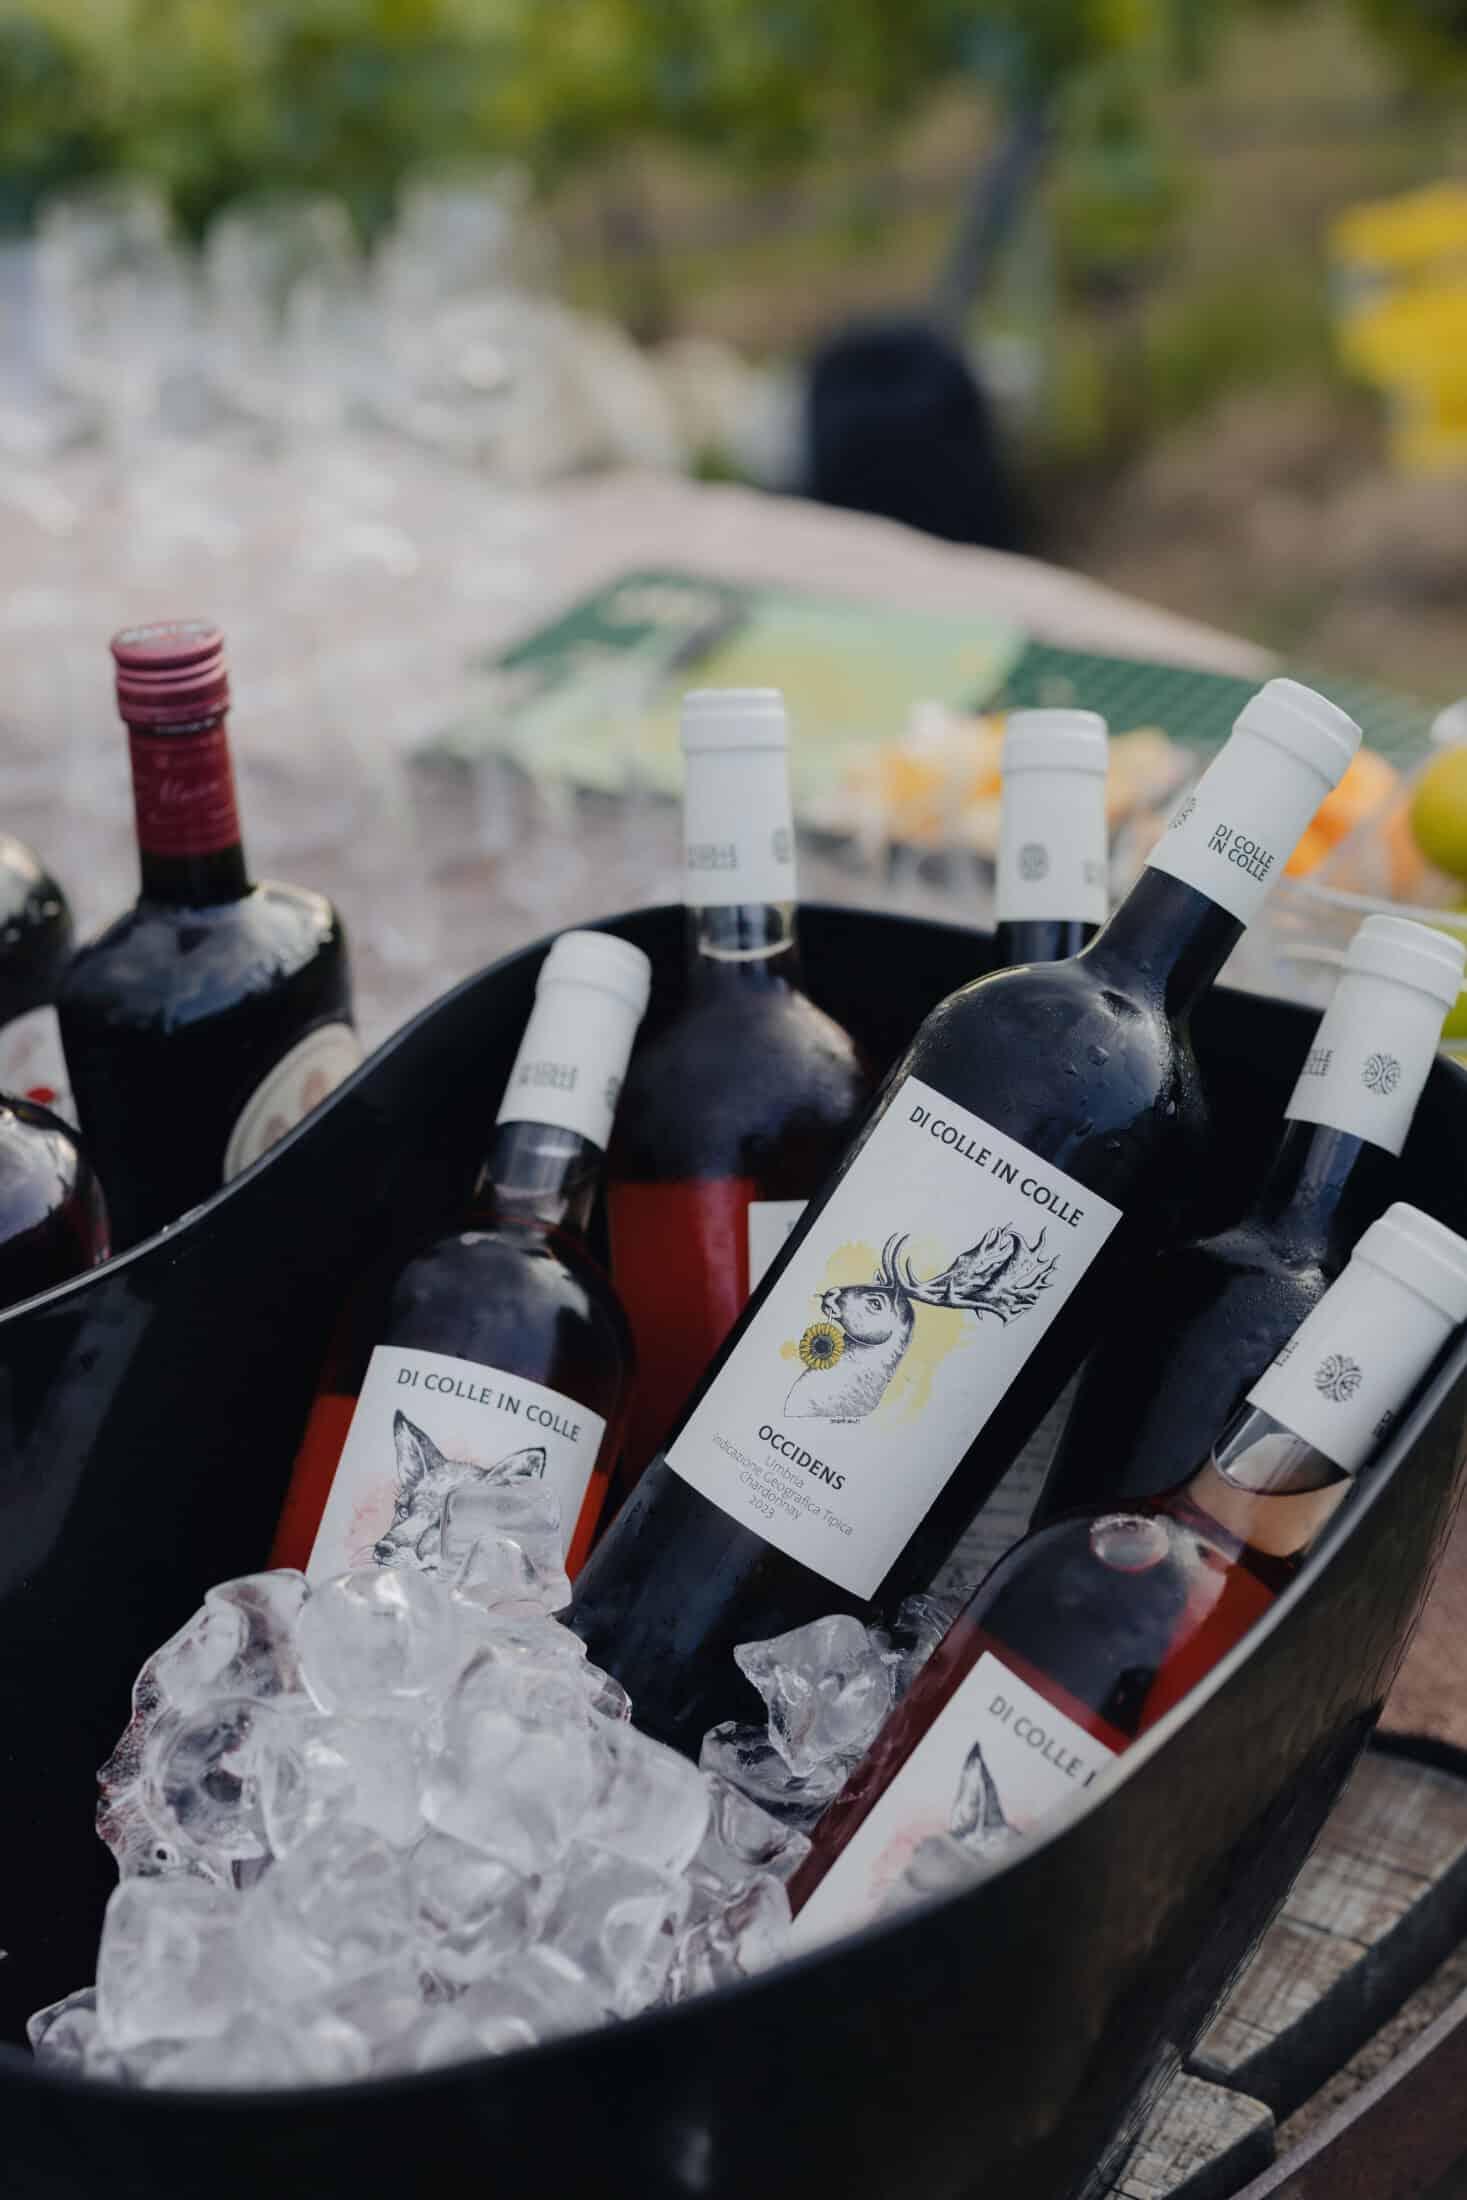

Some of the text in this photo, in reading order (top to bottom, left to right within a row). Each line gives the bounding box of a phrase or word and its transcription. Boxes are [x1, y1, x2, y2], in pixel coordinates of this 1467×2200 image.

[1207, 836, 1269, 882] IN COLLE
[1215, 823, 1275, 869] DI COLLE
[909, 1105, 1085, 1228] DI COLLE IN COLLE
[397, 1368, 582, 1442] DI COLLE IN COLLE
[758, 1424, 846, 1490] OCCIDENS
[765, 1456, 804, 1489] Umbria
[738, 1471, 802, 1521] Chardonnay
[749, 1494, 776, 1520] 2023
[762, 1470, 821, 1515] Geografica
[823, 1508, 854, 1537] Tipica
[989, 1695, 1014, 1722] DI
[1014, 1717, 1084, 1778] COLLE
